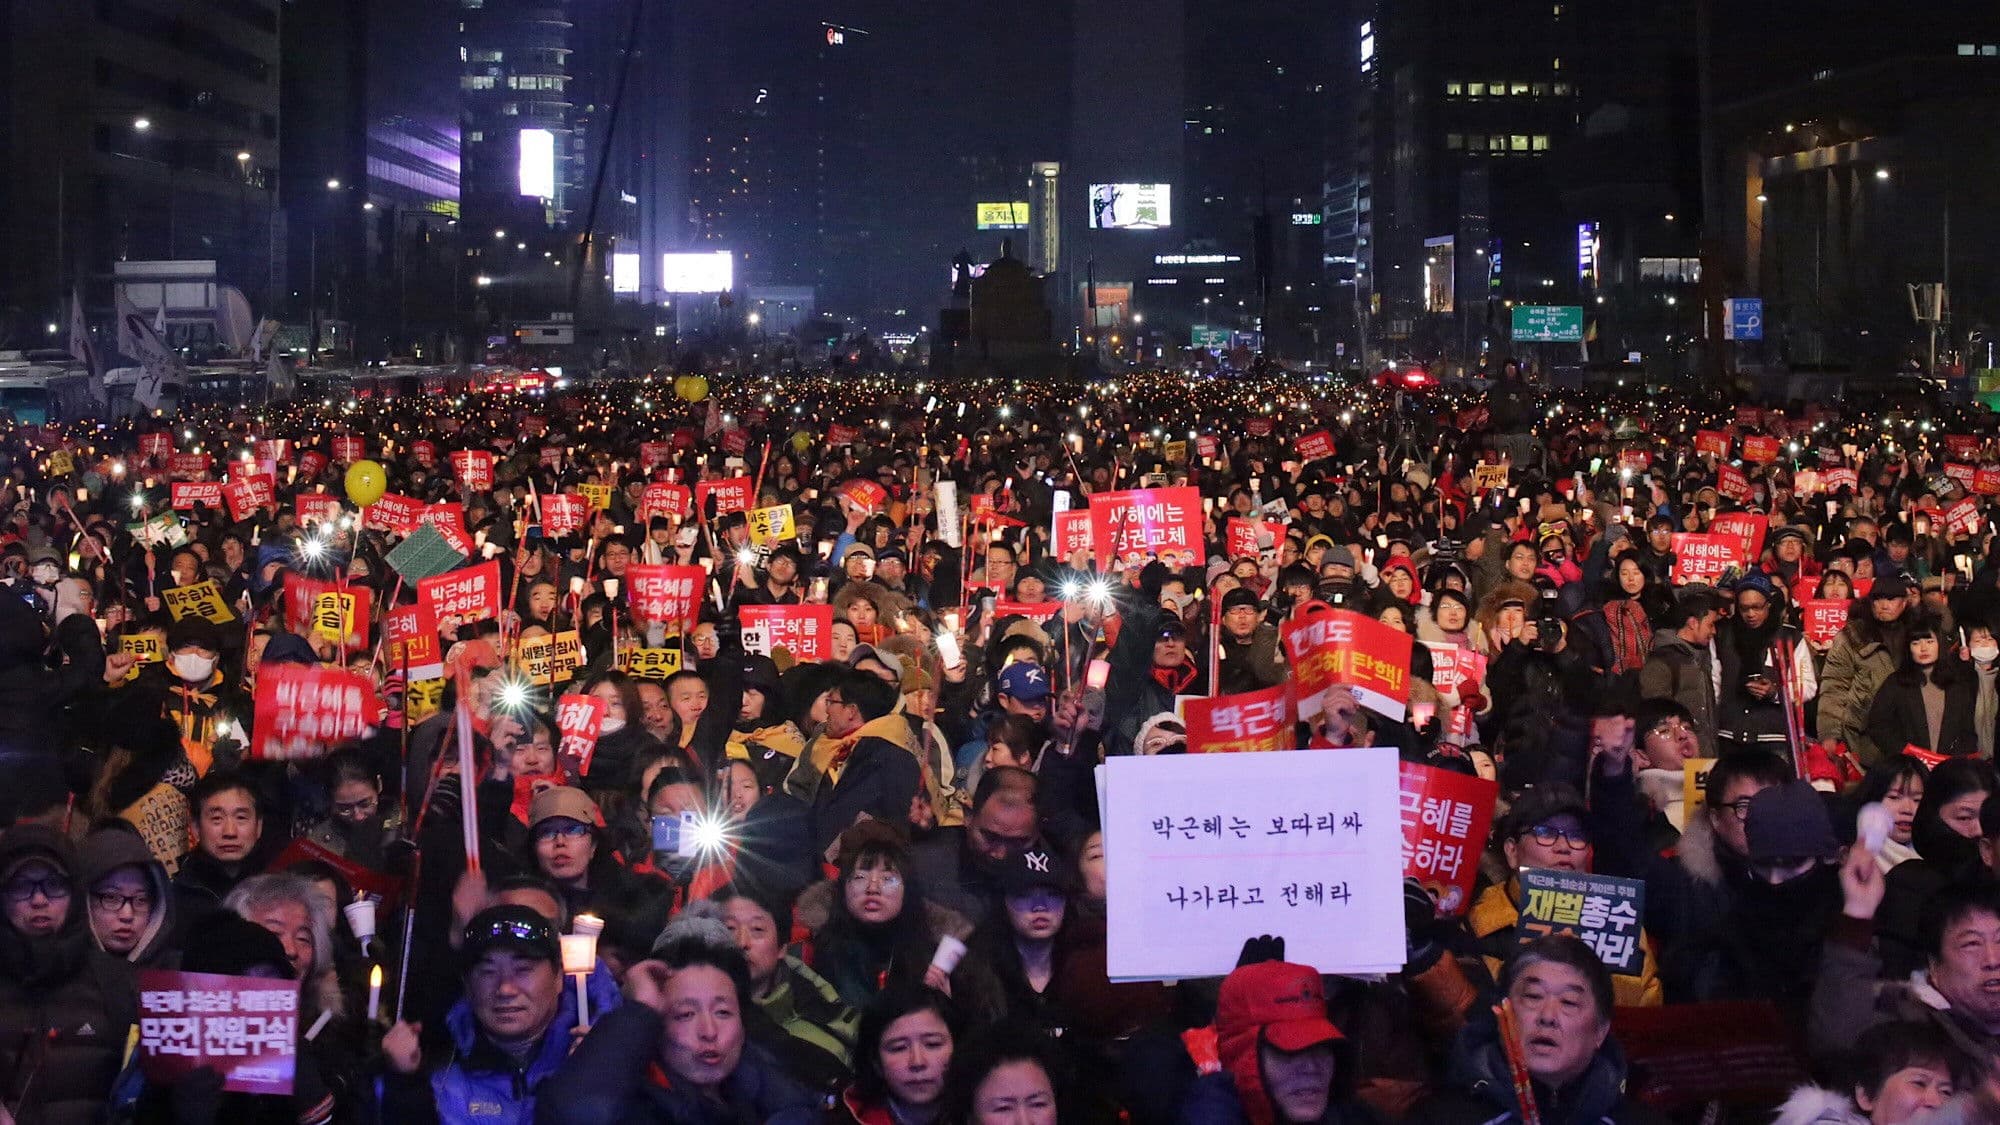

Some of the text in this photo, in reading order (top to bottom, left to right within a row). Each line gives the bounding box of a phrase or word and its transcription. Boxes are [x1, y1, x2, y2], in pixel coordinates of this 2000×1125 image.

[717, 500, 744, 511] 권교체
[1109, 503, 1184, 525] 새해에는
[1110, 526, 1186, 551] 정권교체
[1684, 544, 1731, 558] 새해에는
[166, 586, 214, 605] 미수습자
[431, 575, 485, 601] 박근혜를
[635, 578, 693, 598] 박근혜를
[433, 592, 486, 618] 구속하라
[754, 618, 817, 636] 박근혜를
[529, 657, 578, 678] 진상규명
[616, 652, 675, 668] 미수습자
[1400, 789, 1473, 838] 근혜를
[1152, 811, 1363, 840] 박근혜는 보따리싸
[1166, 881, 1353, 910] 나가라고 전해라
[140, 1017, 199, 1055] 무조건
